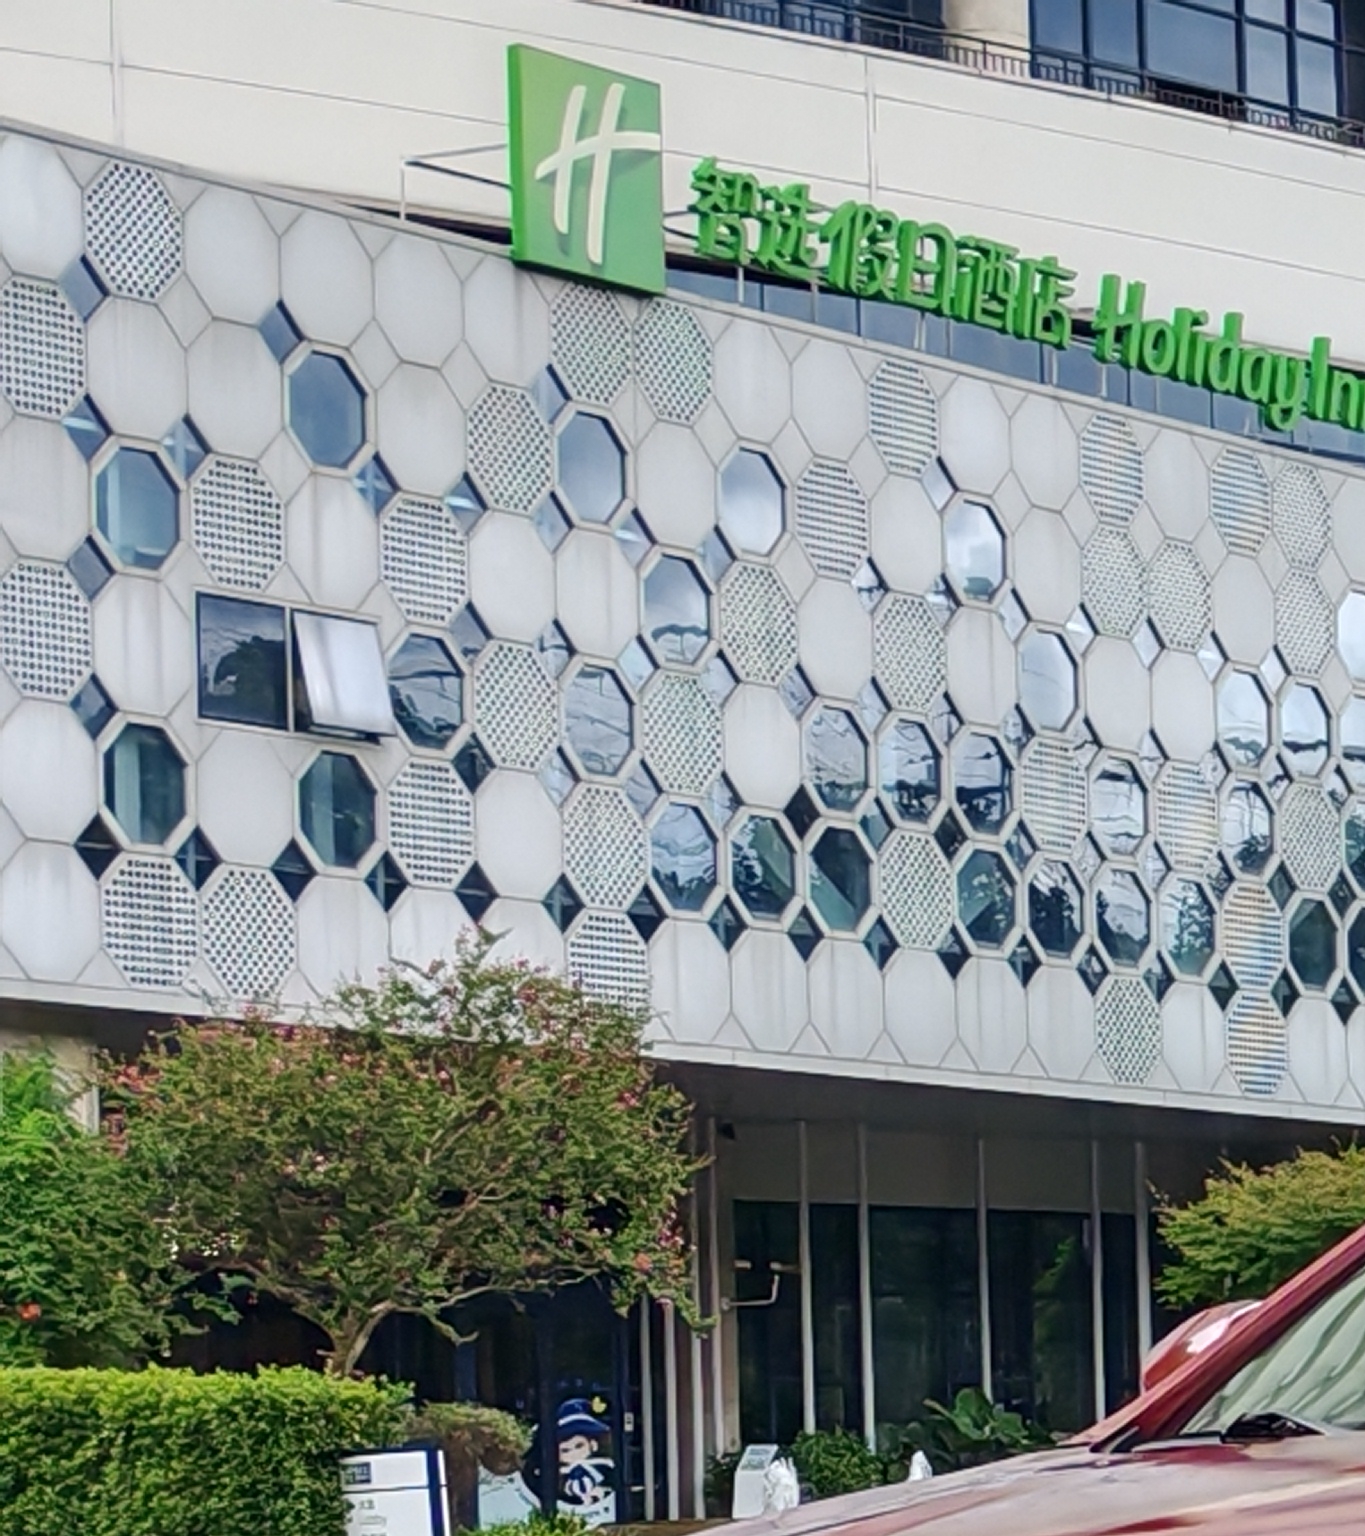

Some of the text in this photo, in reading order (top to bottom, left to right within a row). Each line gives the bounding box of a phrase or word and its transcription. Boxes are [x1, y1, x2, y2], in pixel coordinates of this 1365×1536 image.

[690, 157, 1078, 350] 智选假日酒店
[1091, 273, 1306, 432] Holiday
